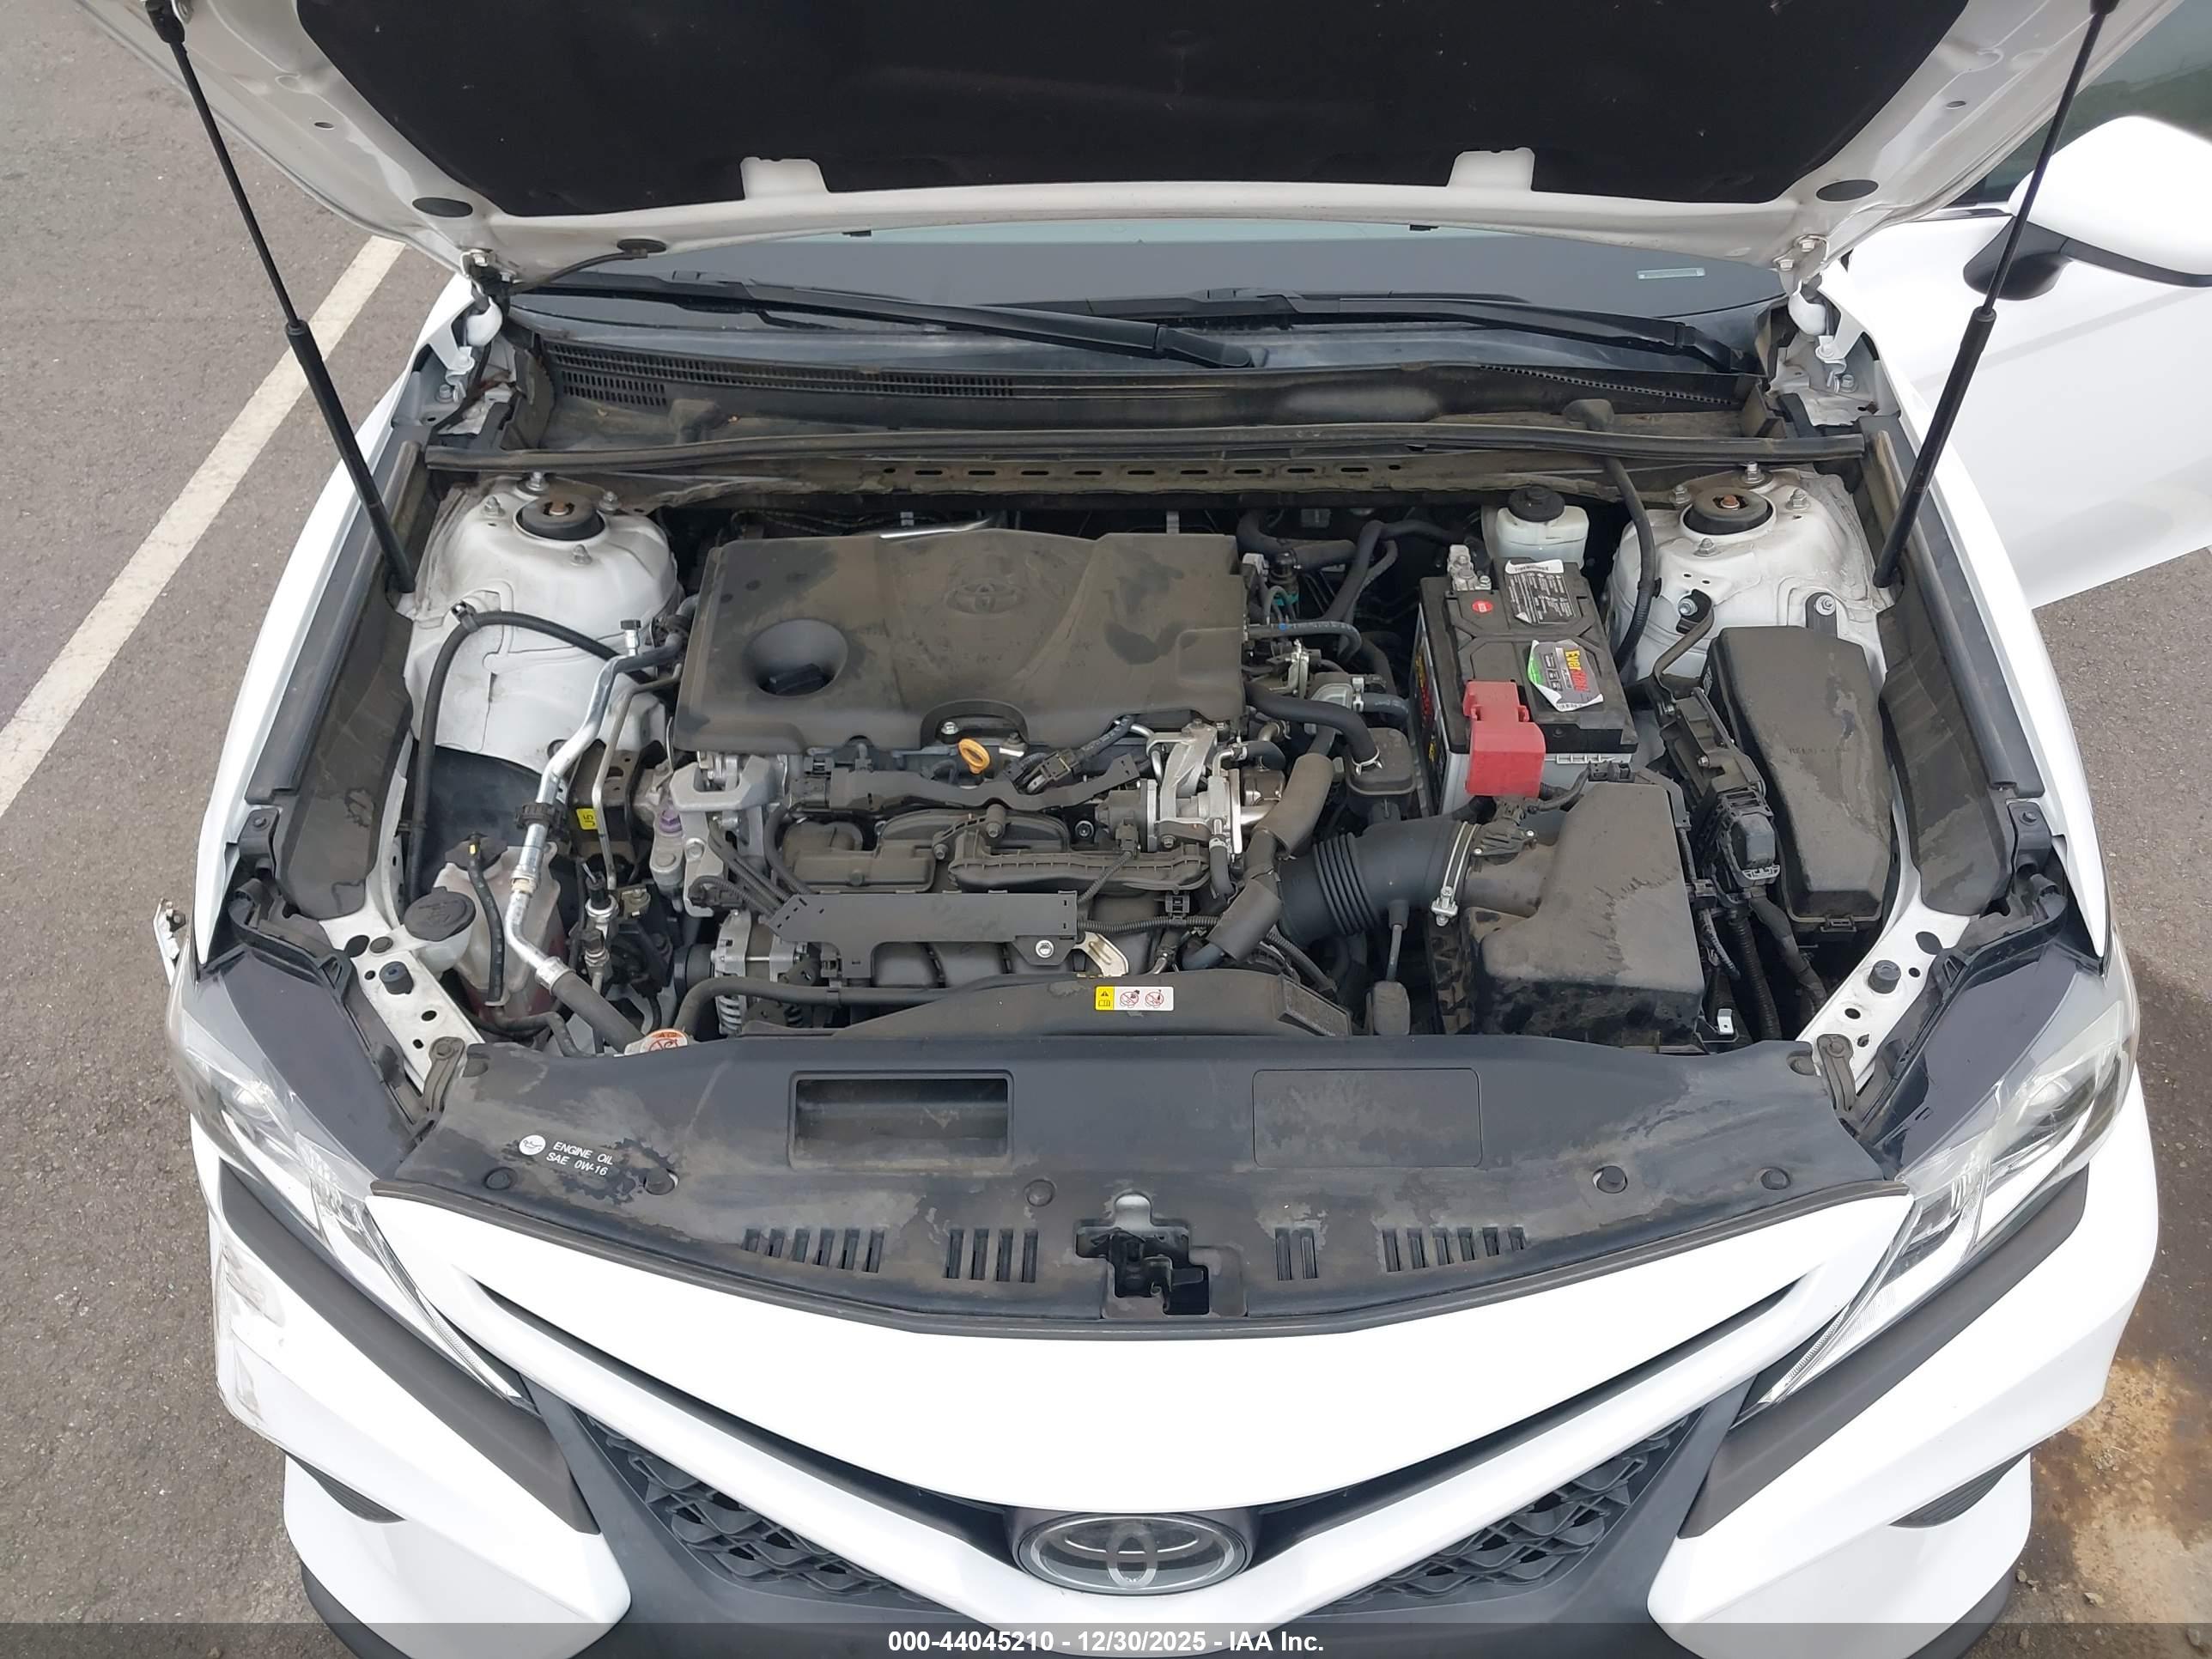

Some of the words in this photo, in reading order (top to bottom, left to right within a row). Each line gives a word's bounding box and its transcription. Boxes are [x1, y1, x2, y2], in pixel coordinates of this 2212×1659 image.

[546, 1152, 570, 1165] SAE
[574, 1159, 608, 1176] 0W-16
[553, 1141, 593, 1159] ENGINE
[597, 1153, 613, 1165] OIL
